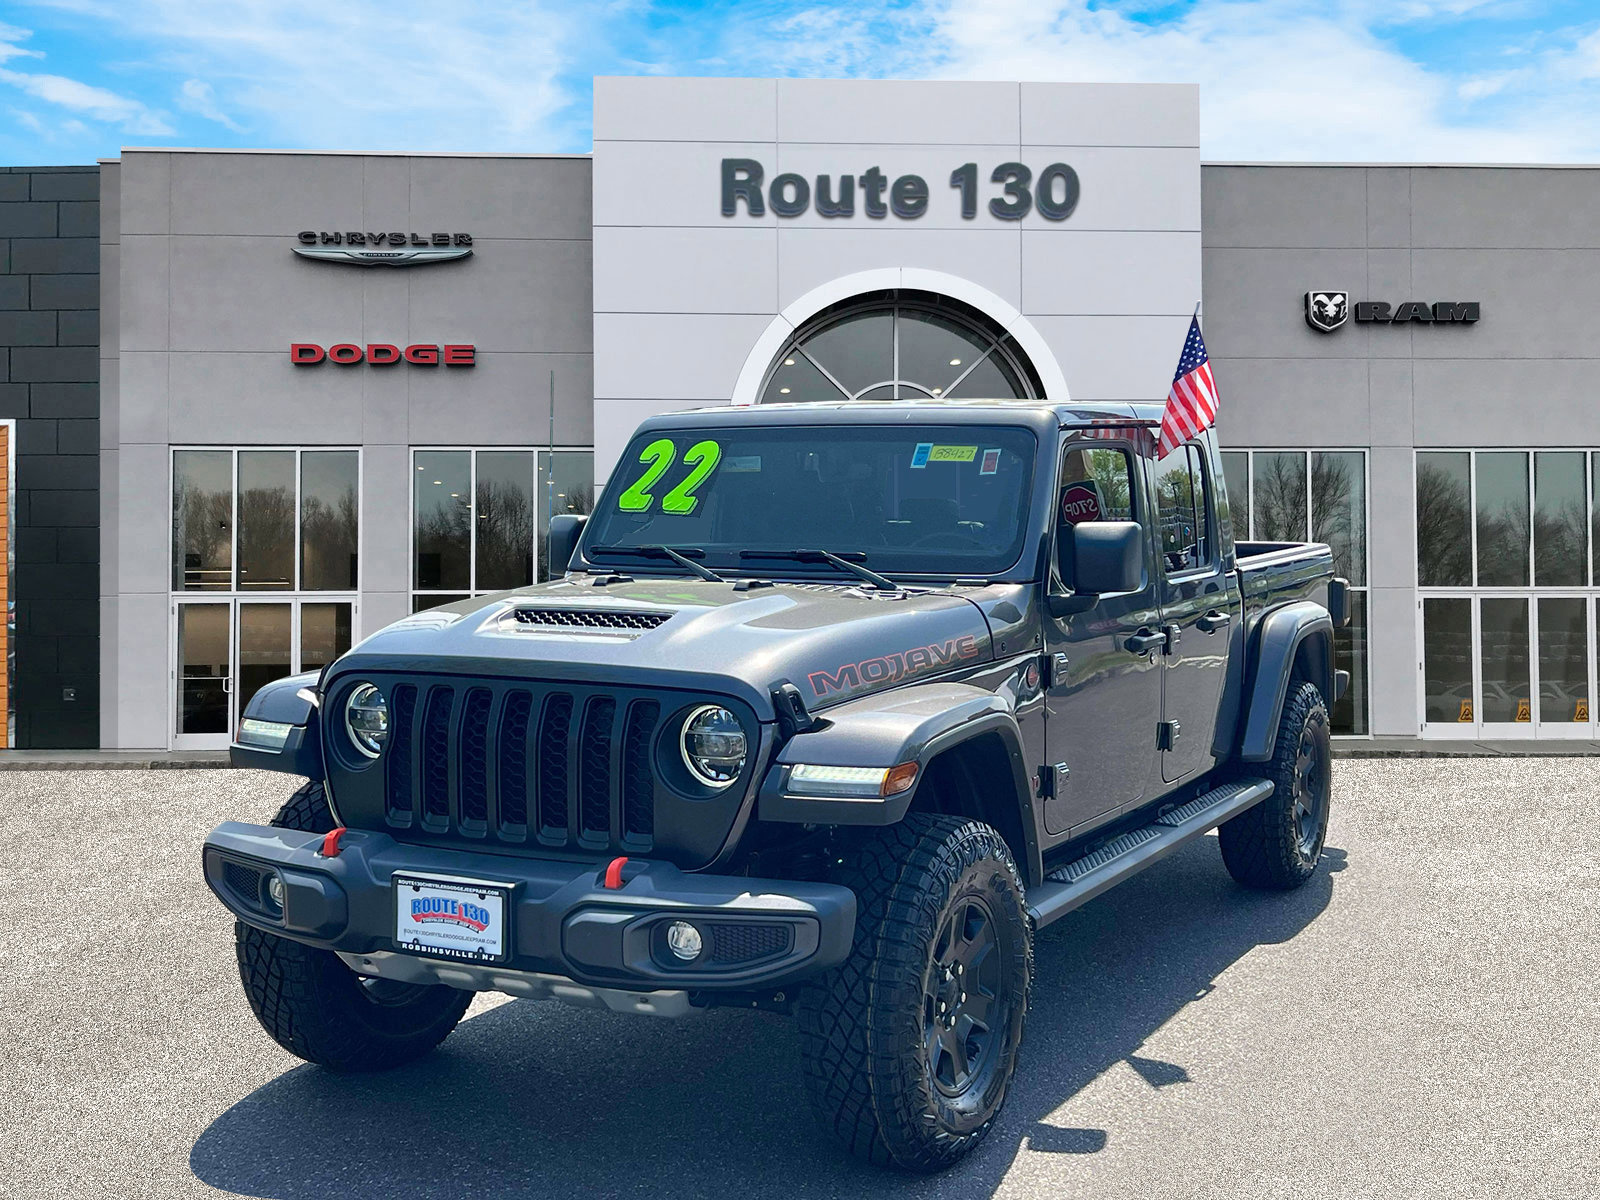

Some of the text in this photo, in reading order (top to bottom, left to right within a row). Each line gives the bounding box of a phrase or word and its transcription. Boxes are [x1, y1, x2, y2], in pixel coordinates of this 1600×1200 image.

[721, 158, 1080, 221] Route 130
[298, 231, 473, 246] CHRYSLER
[1354, 301, 1480, 323] RAM
[291, 343, 476, 364] DODGE
[619, 438, 722, 515] 22
[808, 635, 978, 697] MOJAVE
[411, 897, 490, 926] ROUTE 130
[402, 942, 495, 961] ROBBINSVILLE, NJ
